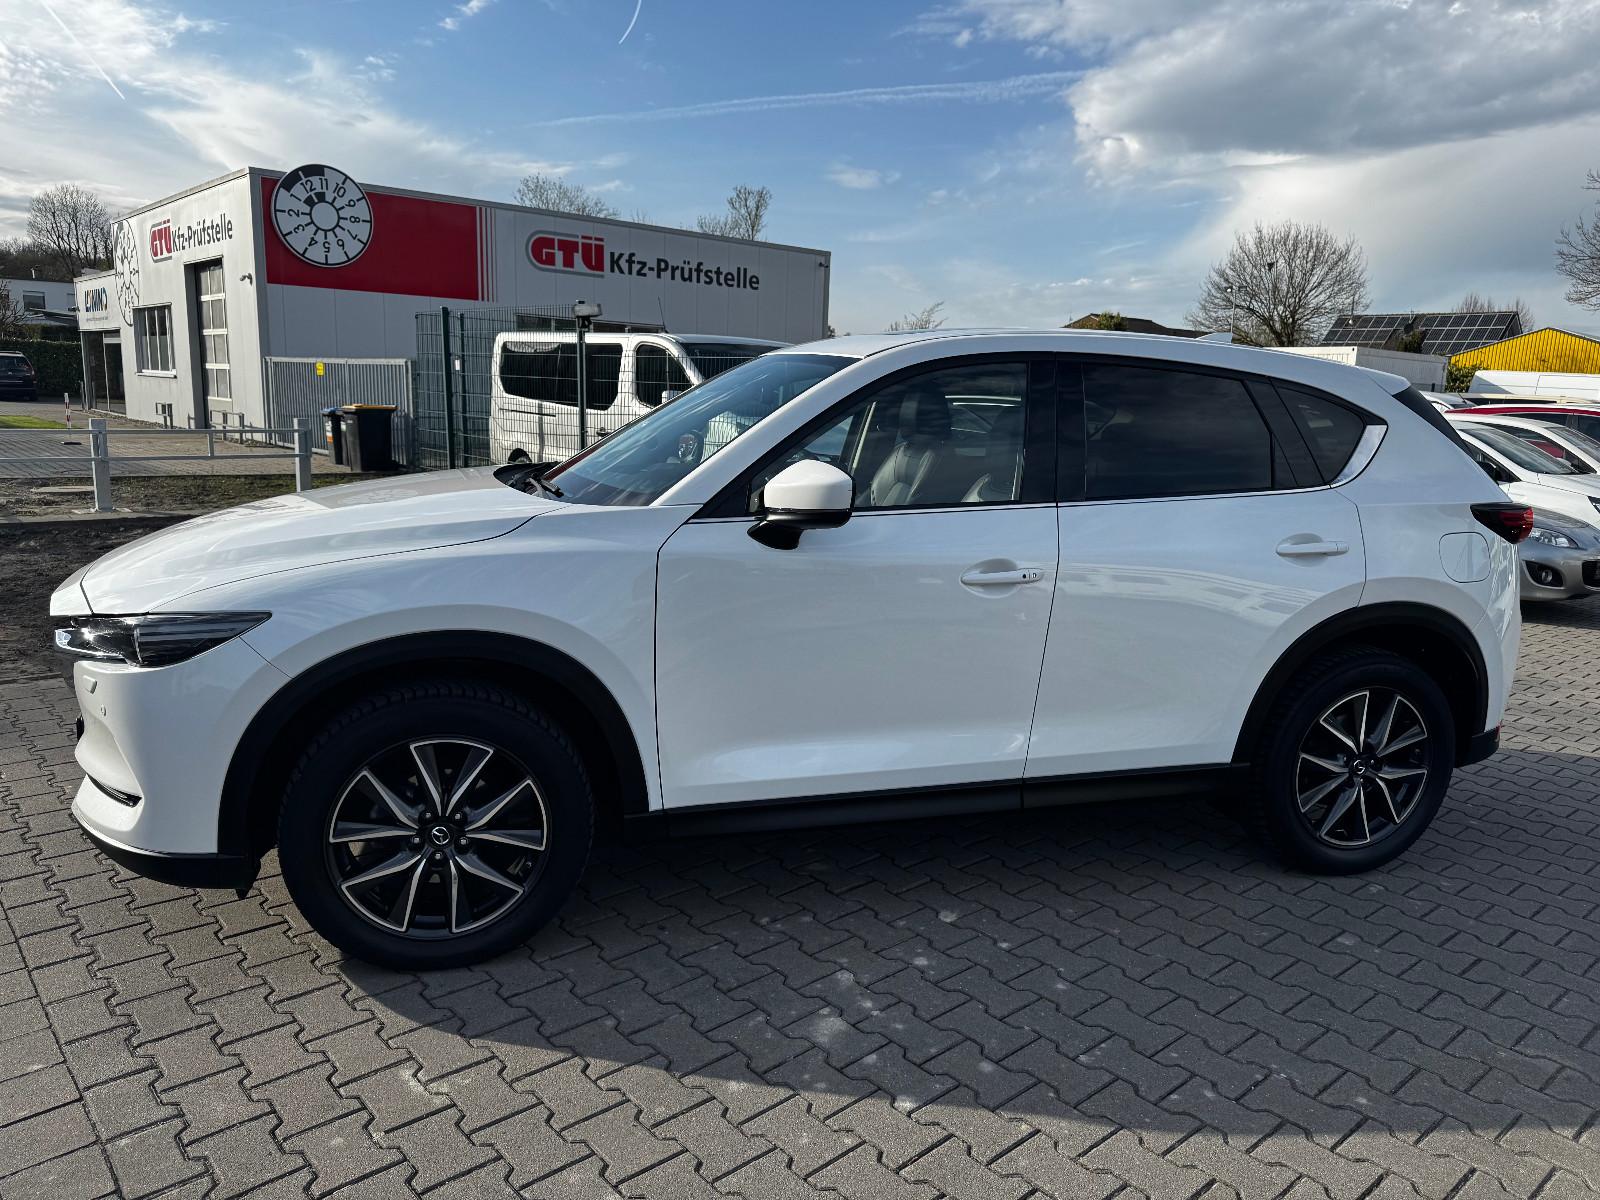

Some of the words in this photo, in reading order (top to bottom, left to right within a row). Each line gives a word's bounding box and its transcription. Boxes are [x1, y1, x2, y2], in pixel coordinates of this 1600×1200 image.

[300, 179, 317, 194] 12
[319, 177, 329, 191] 11
[333, 182, 347, 198] 10
[289, 193, 302, 202] 1
[345, 199, 356, 208] 9
[287, 208, 300, 218] 2
[349, 215, 361, 223] 8
[293, 223, 305, 234] 3
[151, 218, 173, 257] GTÜ
[172, 212, 233, 253] Kfz-Prüfstelle
[347, 229, 358, 240] 7
[308, 236, 318, 247] 4
[322, 241, 331, 253] 5
[336, 239, 345, 250] 6
[530, 235, 605, 273] GTÜ
[609, 250, 760, 291] Kfz-Prüfstelle
